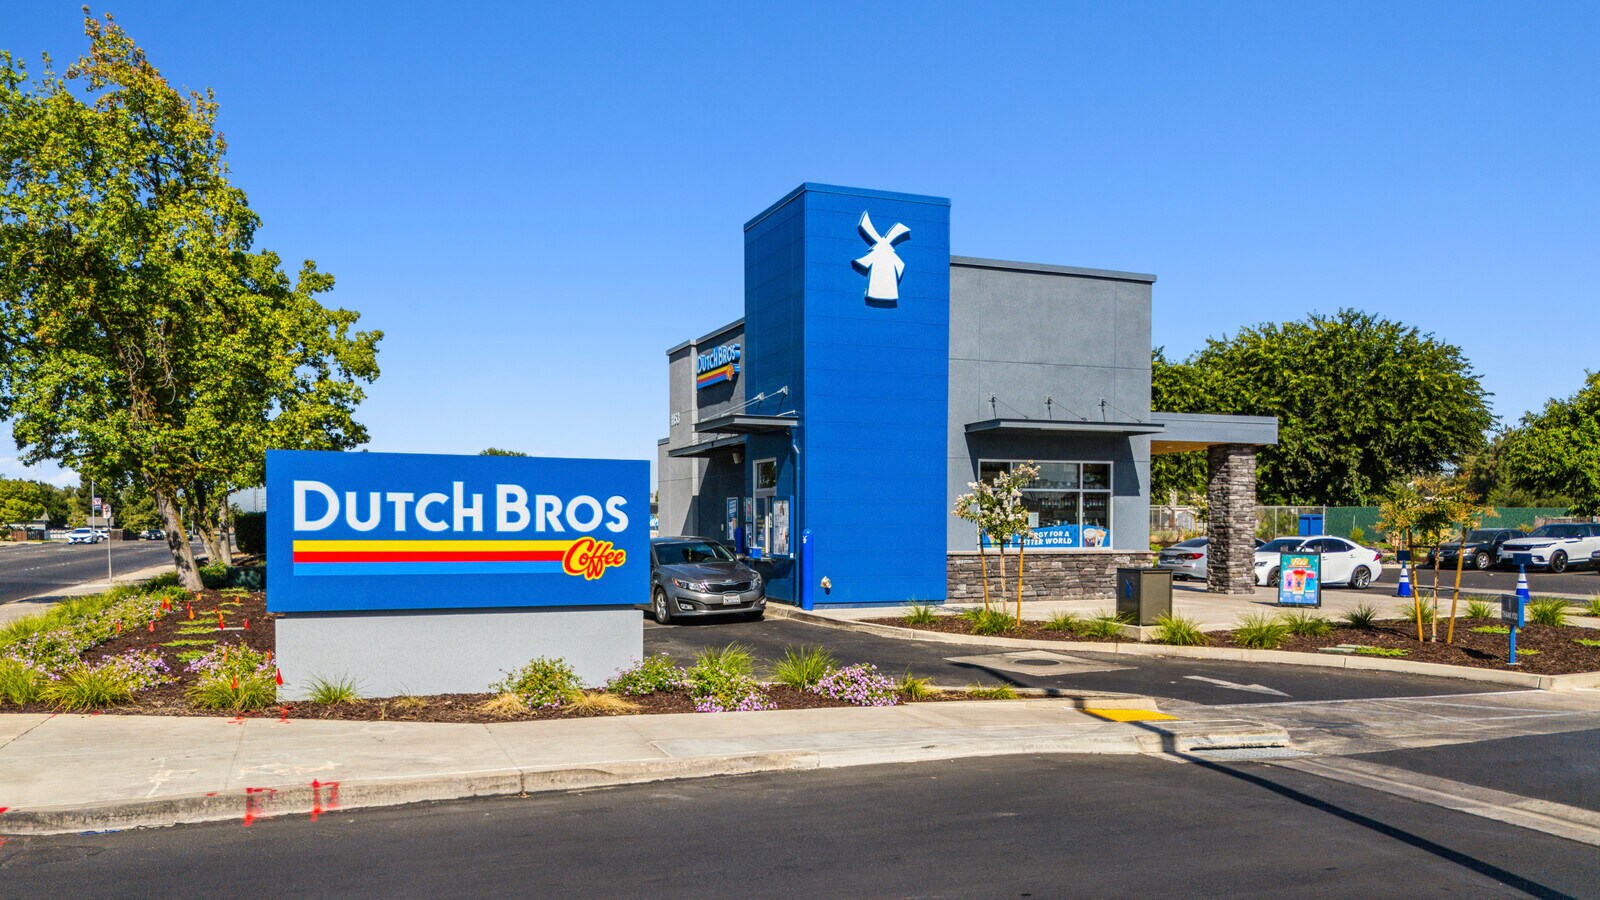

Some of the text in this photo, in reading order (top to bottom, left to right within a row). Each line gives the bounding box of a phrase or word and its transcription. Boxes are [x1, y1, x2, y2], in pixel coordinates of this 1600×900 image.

[697, 346, 719, 374] DUTCH
[718, 344, 736, 366] BROS
[293, 480, 629, 533] DUTCH BROS
[563, 538, 626, 580] Coffee
